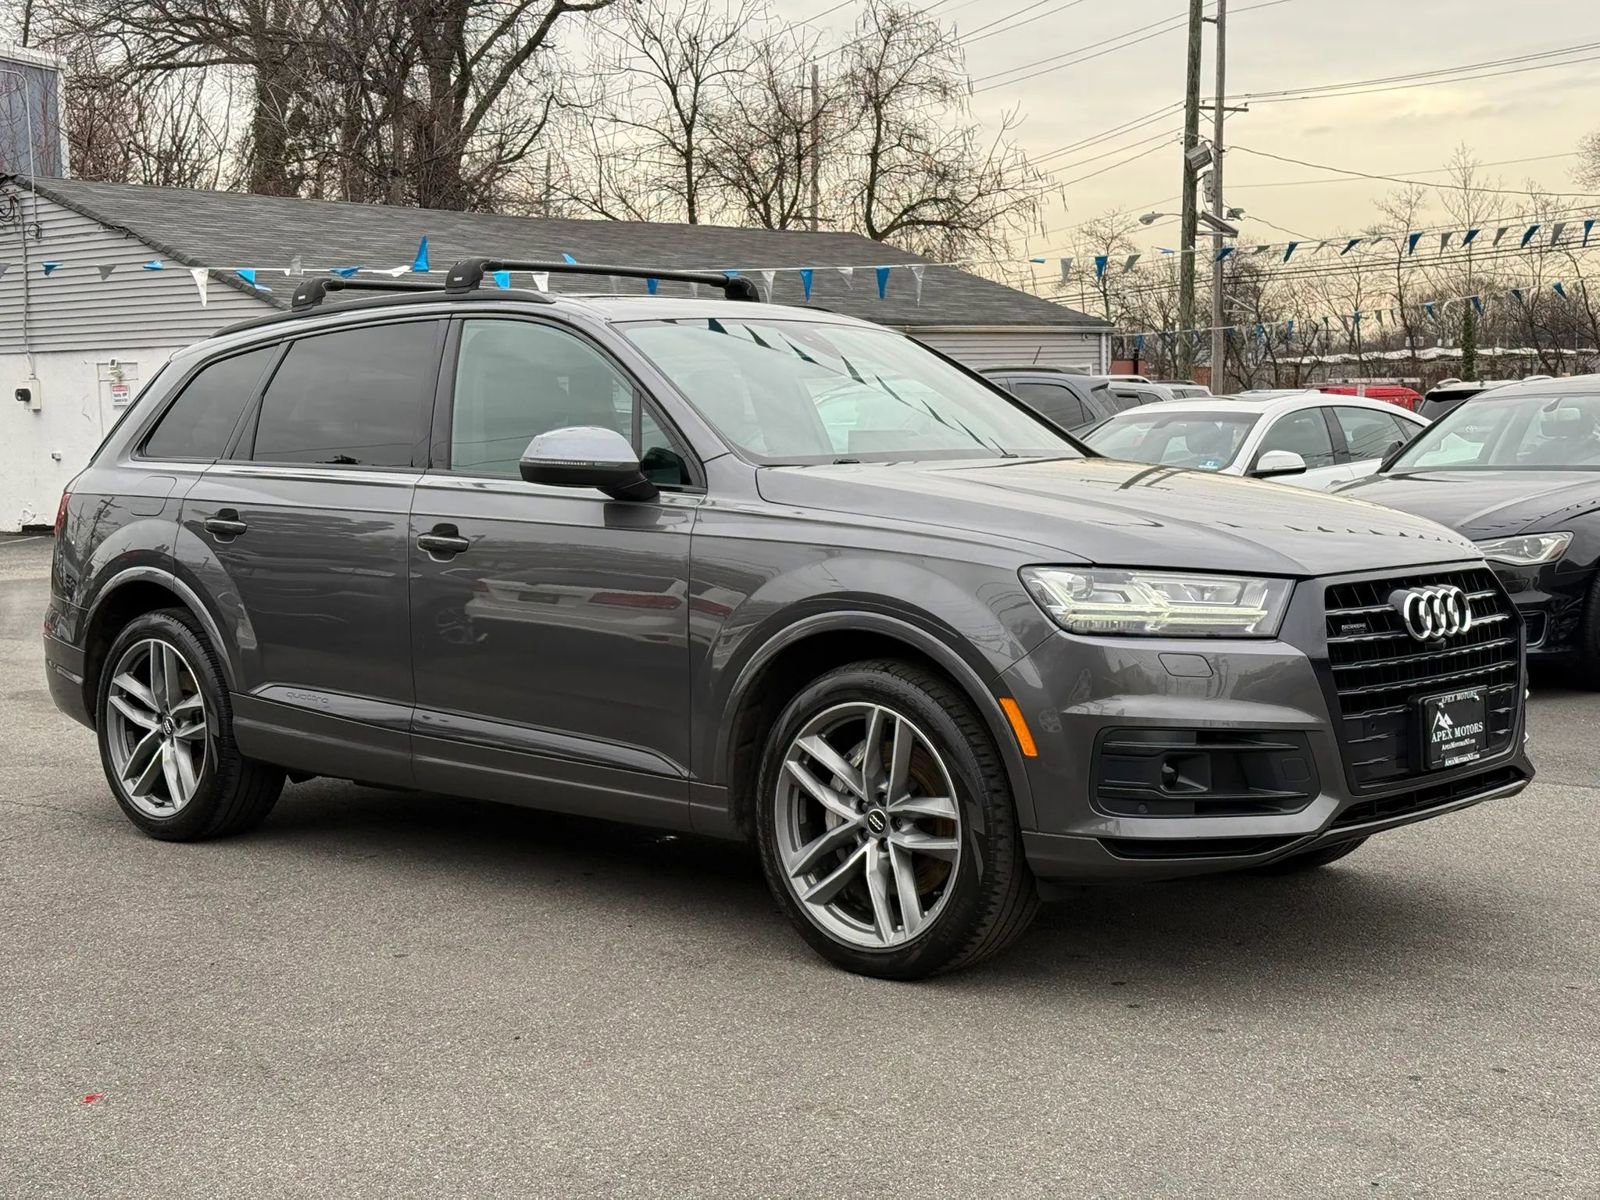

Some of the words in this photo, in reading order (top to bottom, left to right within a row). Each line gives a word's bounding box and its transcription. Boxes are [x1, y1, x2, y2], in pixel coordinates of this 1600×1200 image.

[1441, 693, 1455, 704] APEX
[1431, 728, 1453, 743] APEX
[1454, 721, 1484, 738] MOTORS
